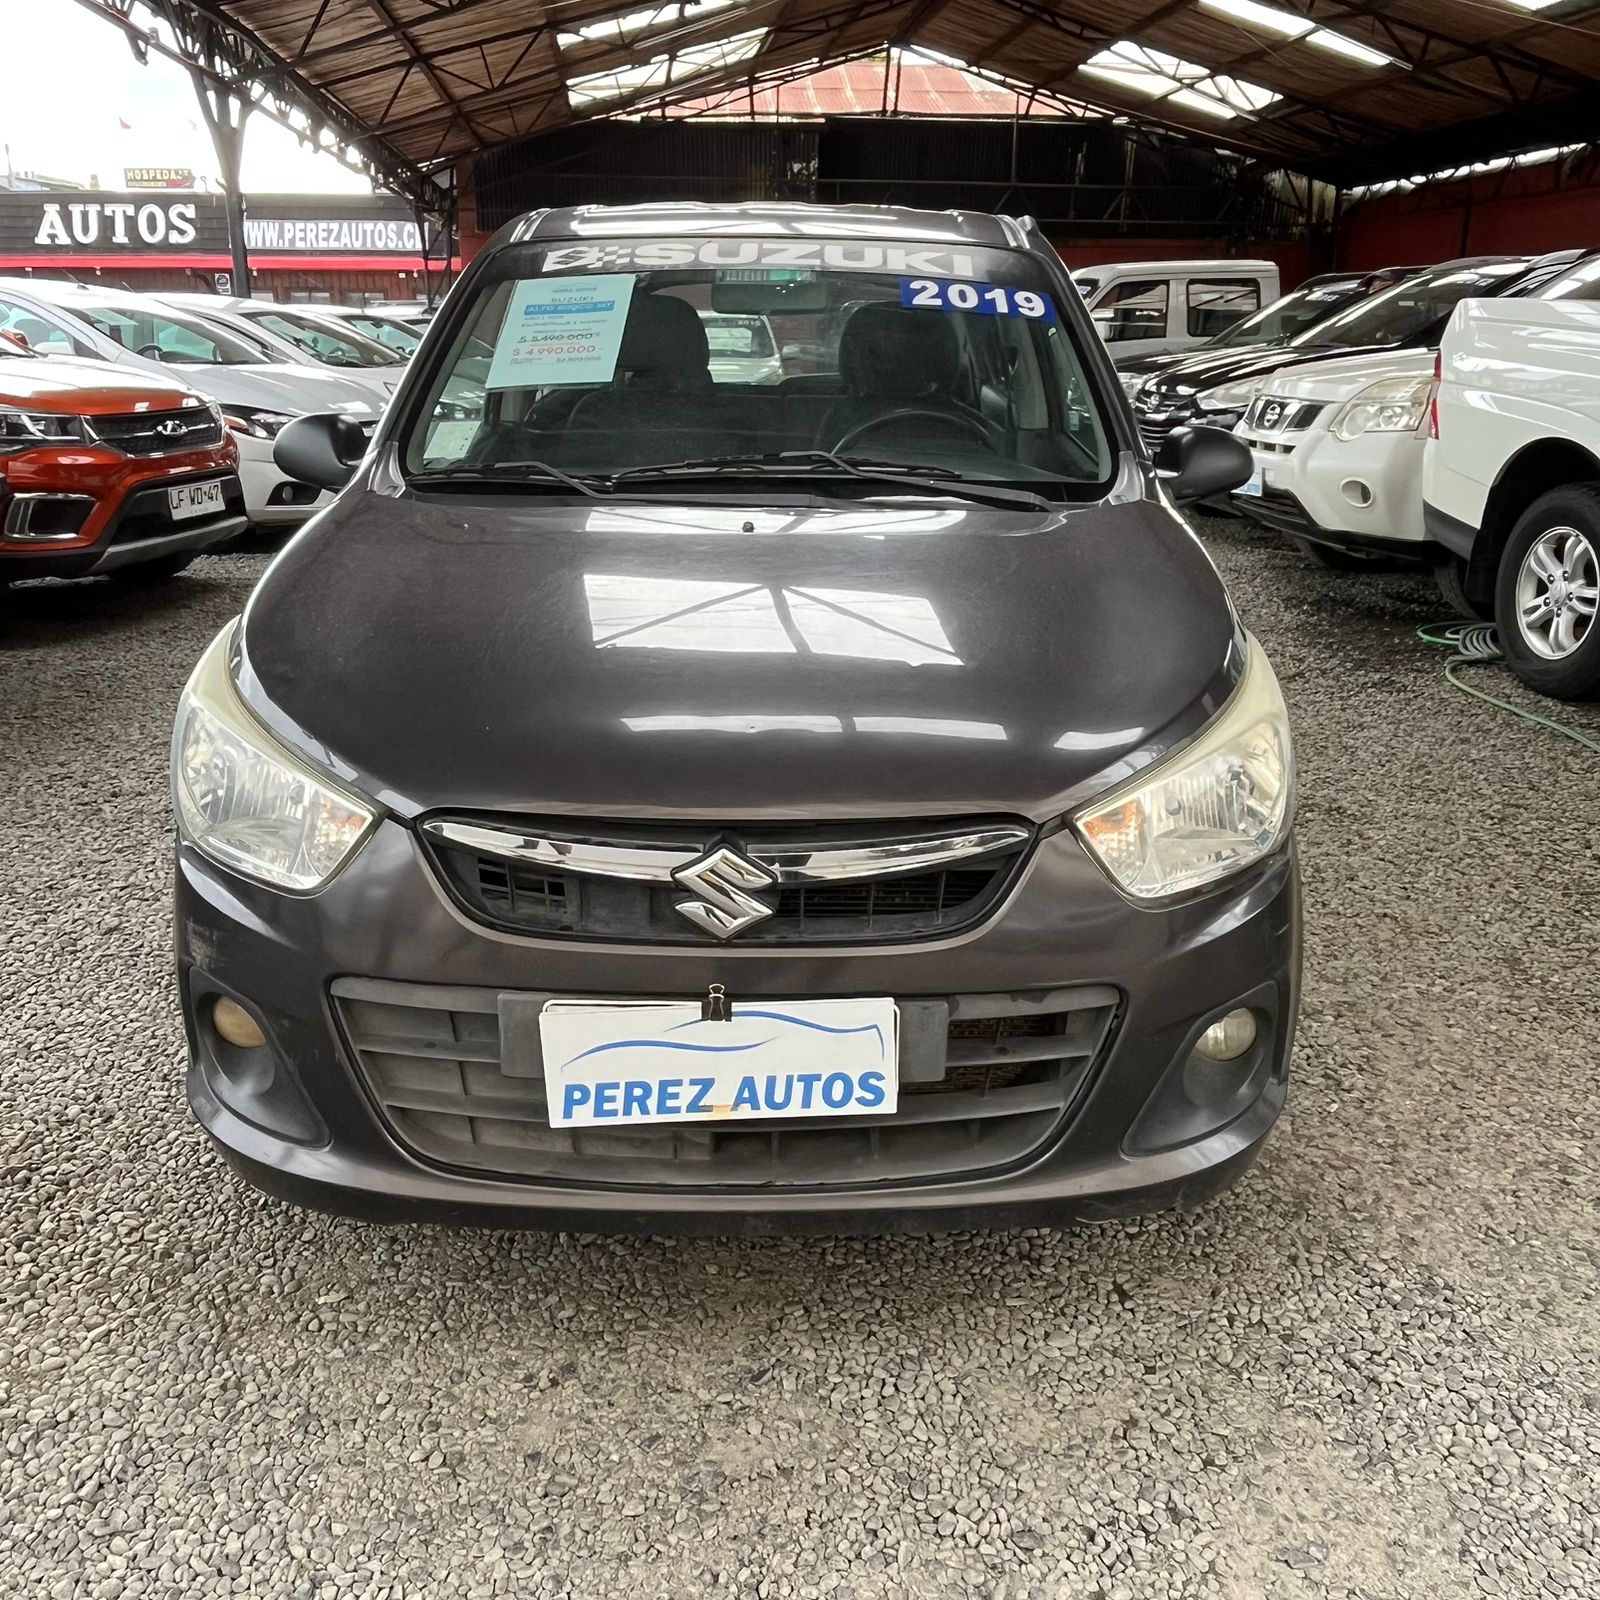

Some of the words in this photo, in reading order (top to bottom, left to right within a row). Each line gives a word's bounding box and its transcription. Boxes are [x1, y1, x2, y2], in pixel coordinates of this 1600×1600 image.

[34, 203, 196, 245] AUTOS
[634, 242, 974, 276] SUZUKI
[909, 280, 1045, 317] 2019
[562, 1077, 715, 1120] PEREZ
[730, 1071, 886, 1112] AUTOS
